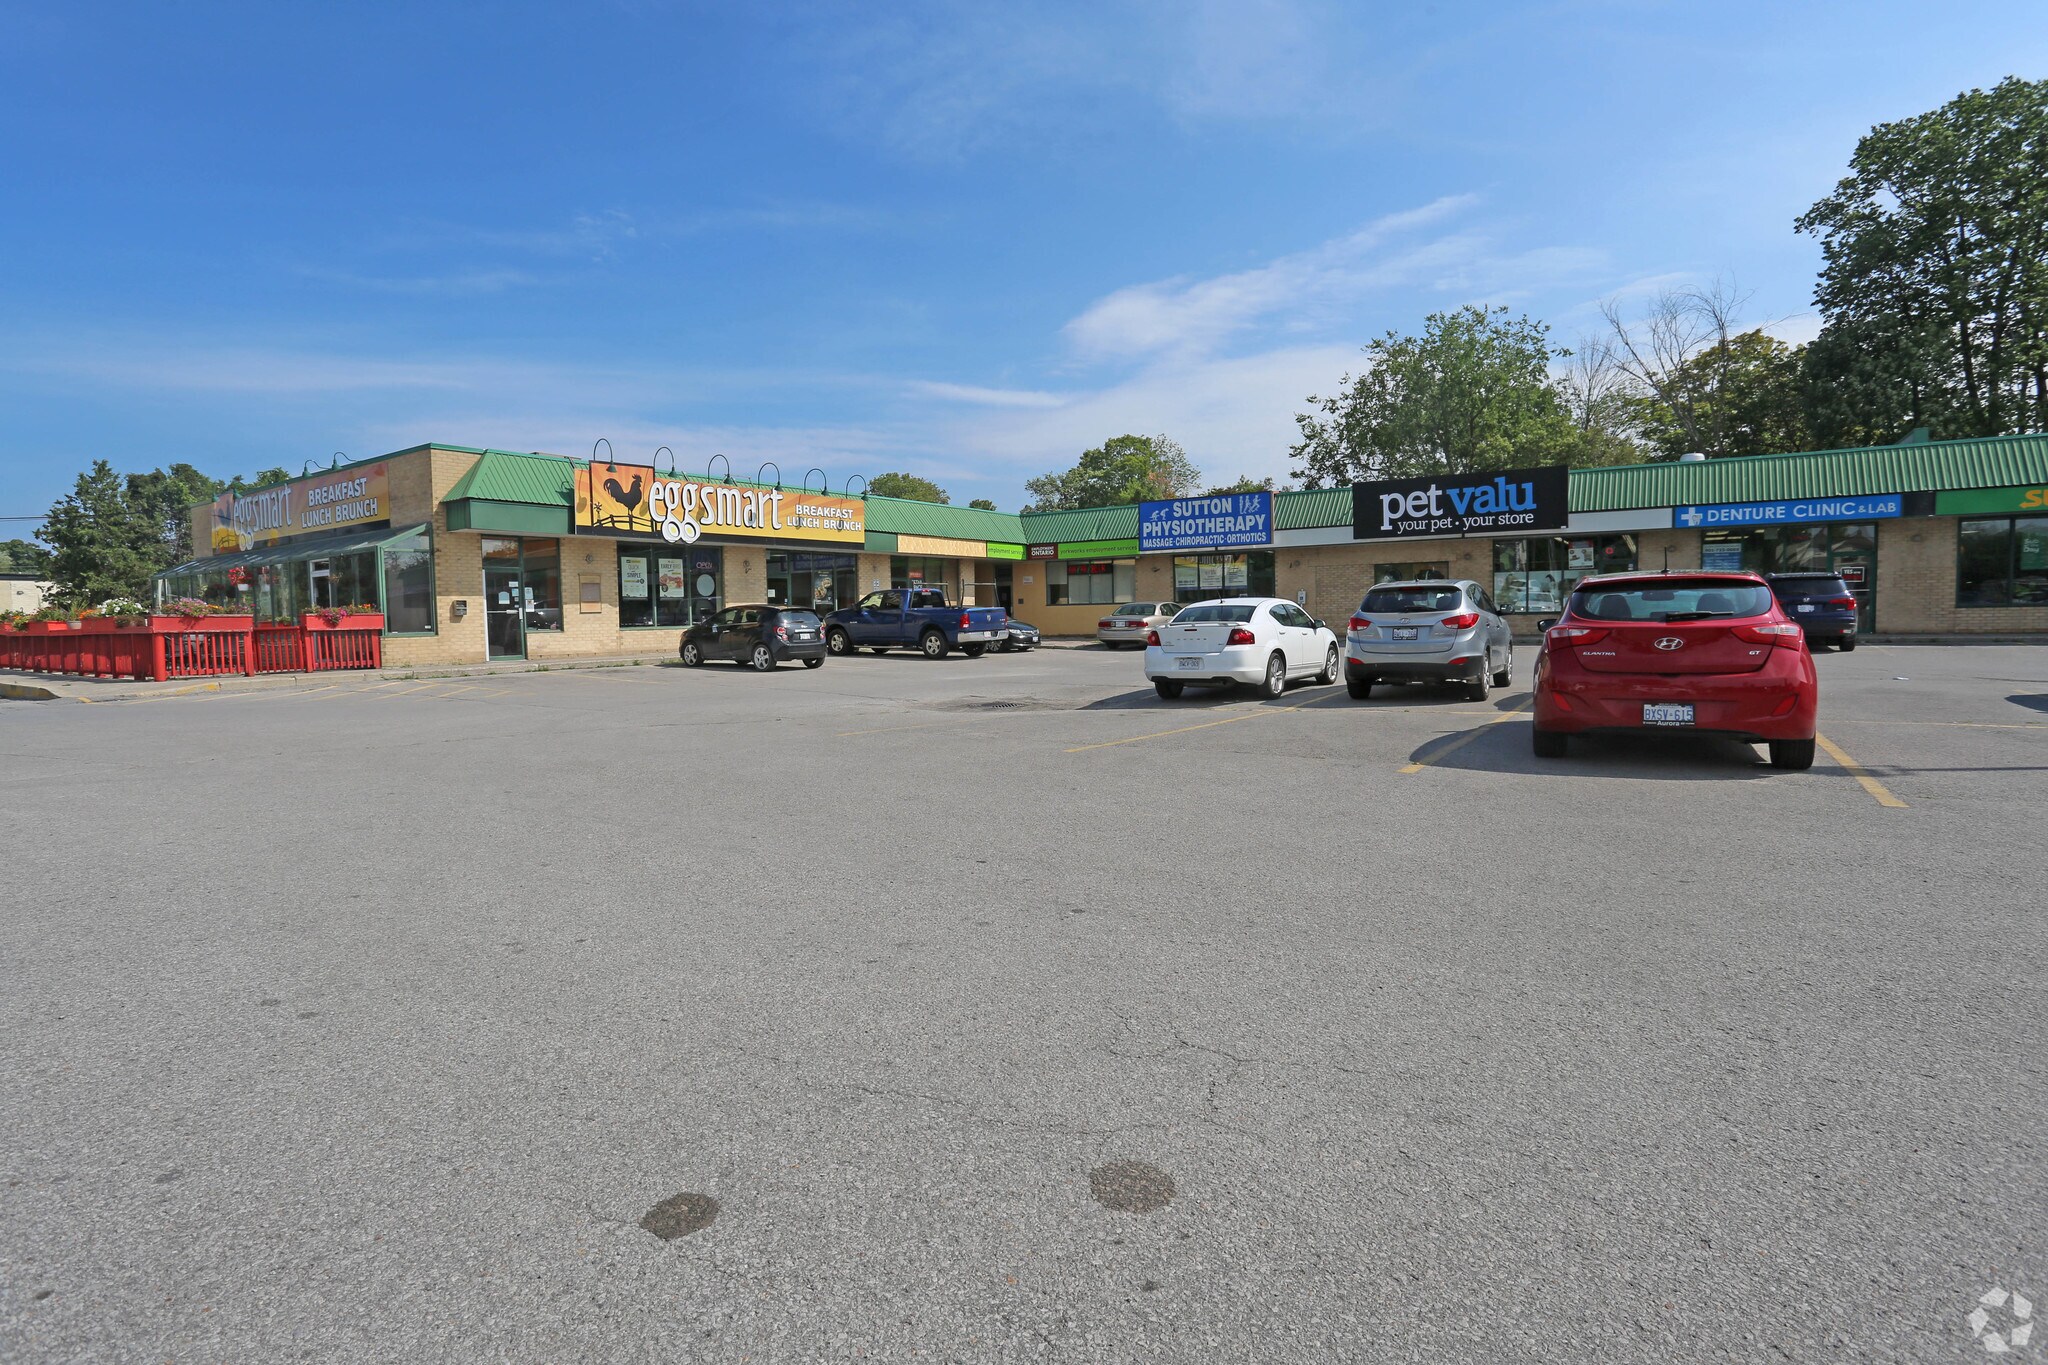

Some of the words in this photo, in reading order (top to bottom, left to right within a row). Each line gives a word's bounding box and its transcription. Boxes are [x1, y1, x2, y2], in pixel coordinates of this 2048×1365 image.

[308, 477, 367, 507] BREAKFAST
[1379, 484, 1443, 531] pet
[1446, 476, 1537, 515] valu
[233, 483, 292, 551] eggsmart
[301, 507, 332, 529] LUNCH
[335, 498, 378, 522] BRUNCH
[649, 480, 784, 543] eggsmart
[795, 504, 854, 519] BREAKFAST
[1173, 498, 1232, 517] SUTTON
[1707, 506, 1785, 522] DENTURE
[1793, 502, 1855, 518] CLINIC
[1858, 505, 1866, 513] &
[1868, 502, 1896, 514] LAB
[787, 516, 820, 529] LUNCH
[823, 518, 862, 531] BRUNCH
[1142, 514, 1266, 537] PHYSIOTHERAPY
[1397, 519, 1428, 534] your
[1430, 517, 1453, 532] pet
[1462, 515, 1496, 531] your
[1498, 511, 1534, 525] store
[1143, 538, 1173, 548] MASSAGE
[1226, 532, 1267, 543] ORTHOTICS
[1645, 709, 1693, 721] BXSV-615
